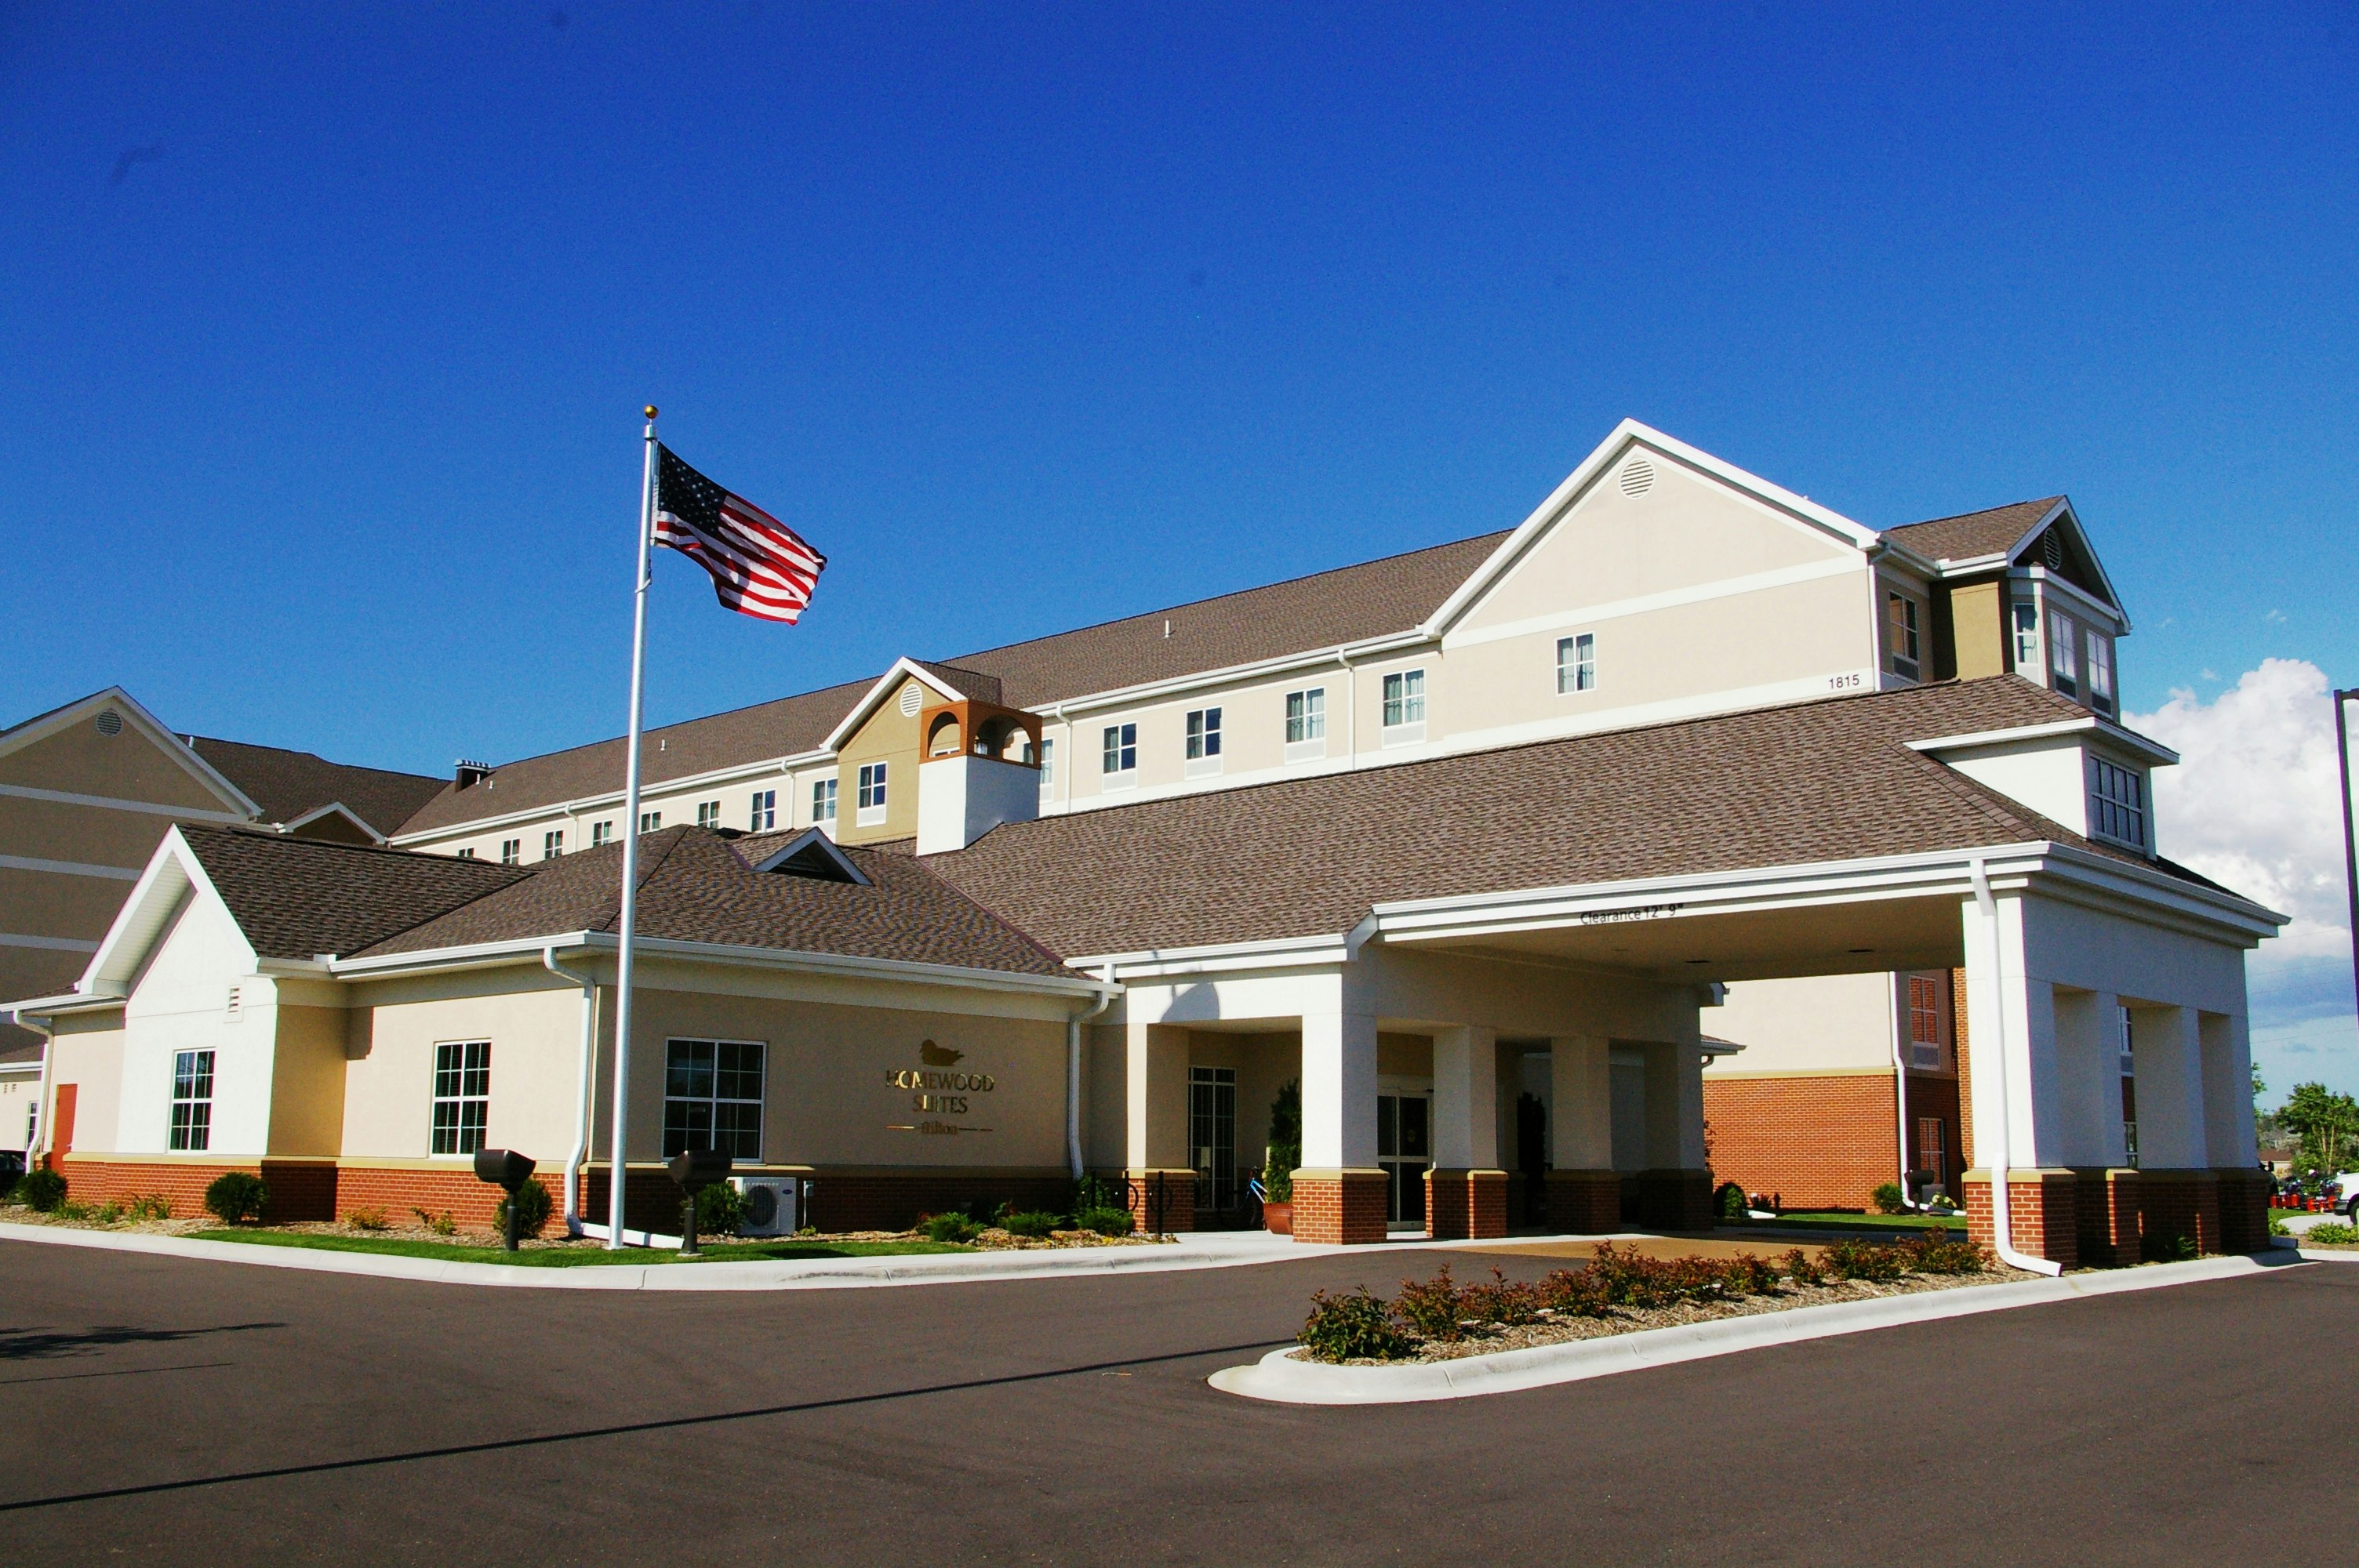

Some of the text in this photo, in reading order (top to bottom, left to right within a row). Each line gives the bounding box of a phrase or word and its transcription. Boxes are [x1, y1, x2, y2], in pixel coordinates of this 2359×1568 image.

[1829, 674, 1859, 689] 1815
[1580, 909, 1641, 924] Clearance
[885, 1069, 994, 1091] HOMEWOOD
[913, 1094, 968, 1113] SUITES
